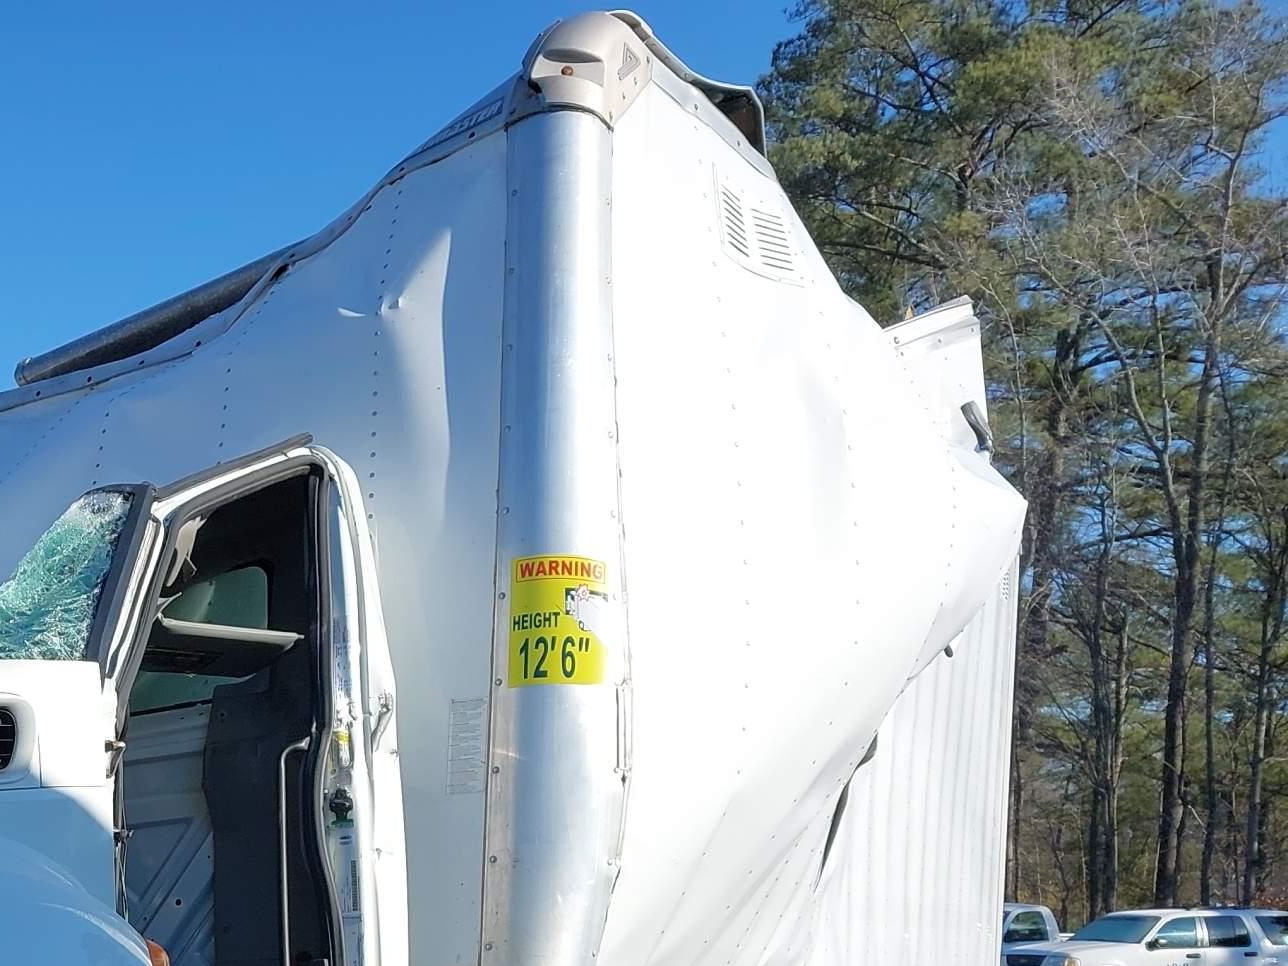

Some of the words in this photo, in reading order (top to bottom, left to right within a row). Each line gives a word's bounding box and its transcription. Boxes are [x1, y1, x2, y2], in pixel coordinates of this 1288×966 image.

[520, 560, 603, 579] WARNING
[513, 612, 560, 631] HEIGHT
[519, 636, 590, 679] 12'6"
